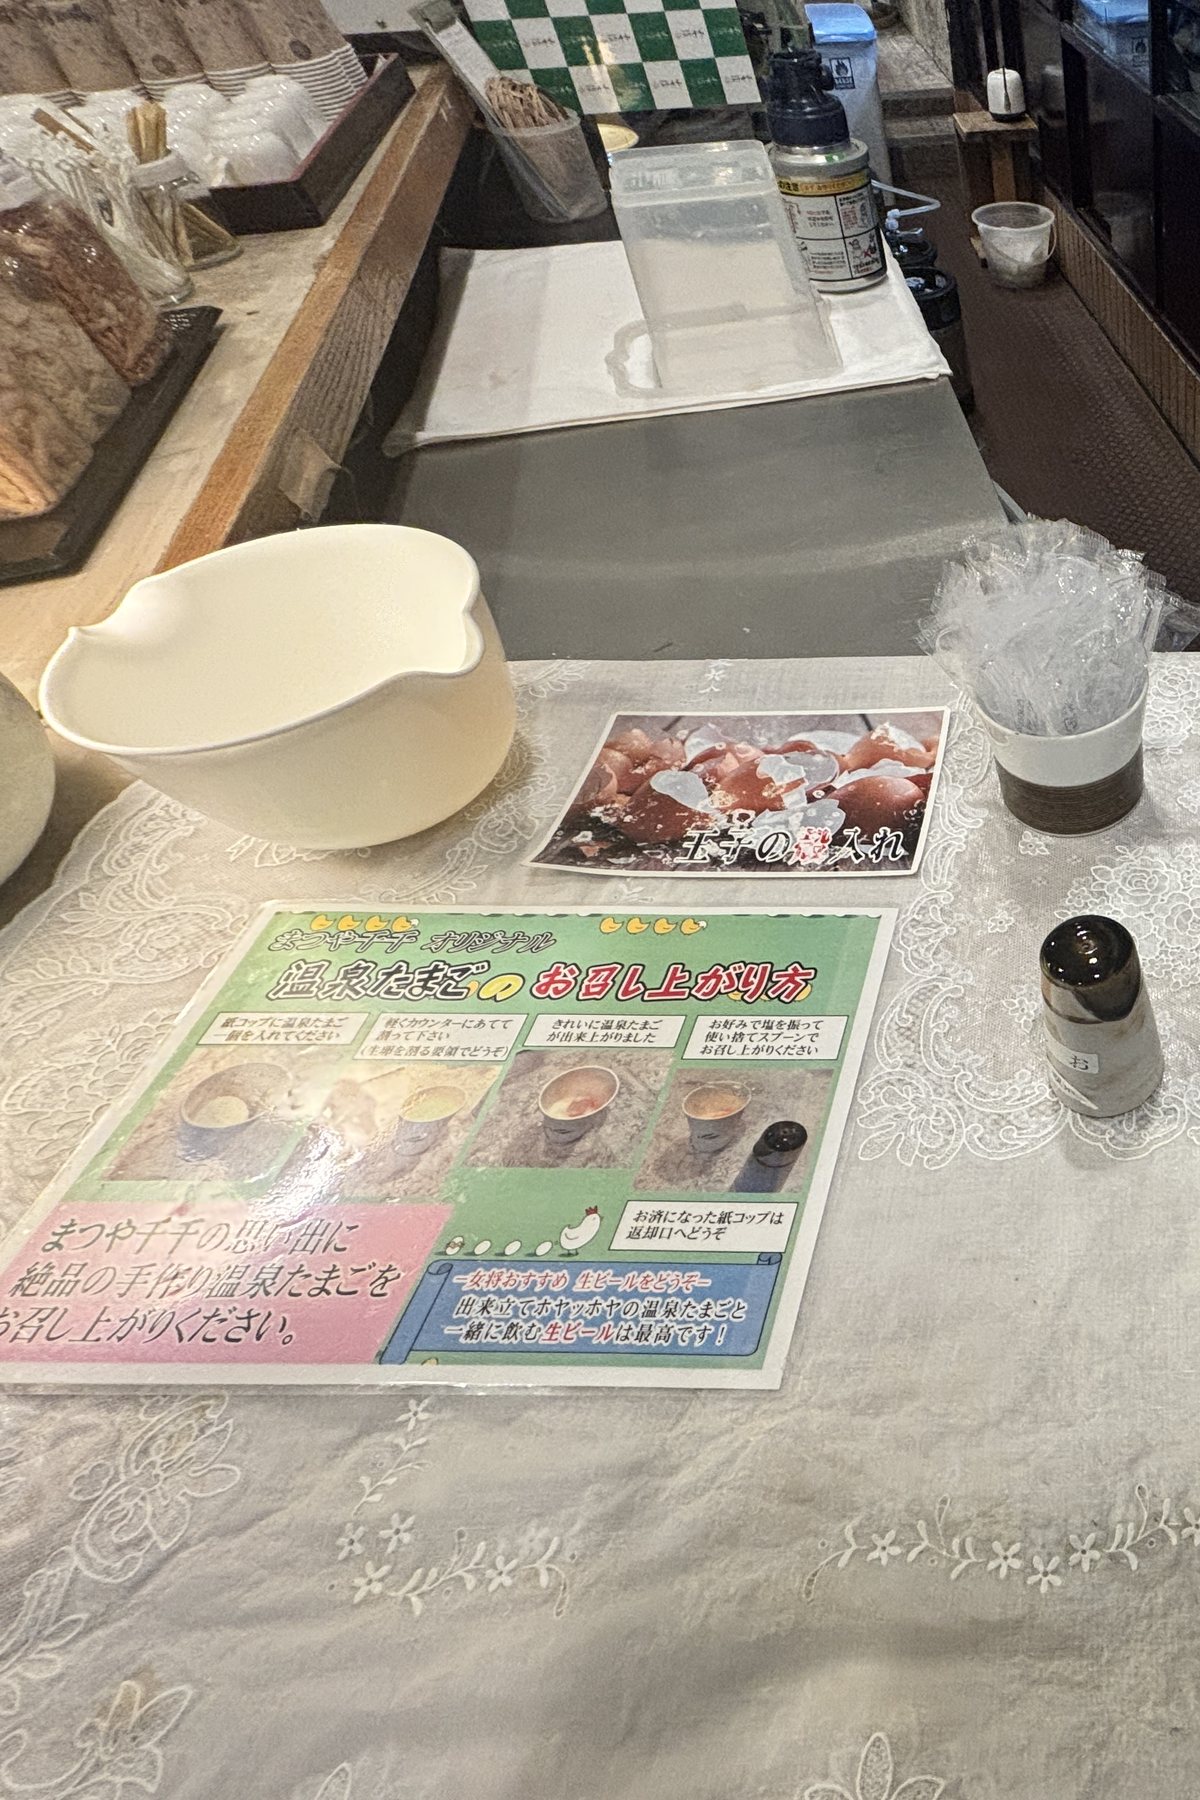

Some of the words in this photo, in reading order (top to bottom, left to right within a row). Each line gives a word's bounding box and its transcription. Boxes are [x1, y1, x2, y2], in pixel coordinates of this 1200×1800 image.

[421, 930, 556, 953] オリジナル
[551, 1018, 664, 1031] きれいに温泉たまご
[708, 1019, 824, 1031] お好みで塩を振って
[546, 1031, 657, 1044] が出来上がりました
[704, 1031, 820, 1043] 使い捨てスプーンで
[699, 1044, 819, 1057] お召し上がりください
[632, 1208, 785, 1226] お済になった紙コップは
[40, 1217, 360, 1255] まつや千千の思い出に
[625, 1225, 728, 1241] 返却口へどうぞ
[8, 1260, 402, 1300] 絶品の手作り温泉たまごを
[454, 1297, 747, 1321] 出来立てホヤッホヤの温泉たまごと
[444, 1323, 728, 1347] 一緒に飲む生ビールは最高です！
